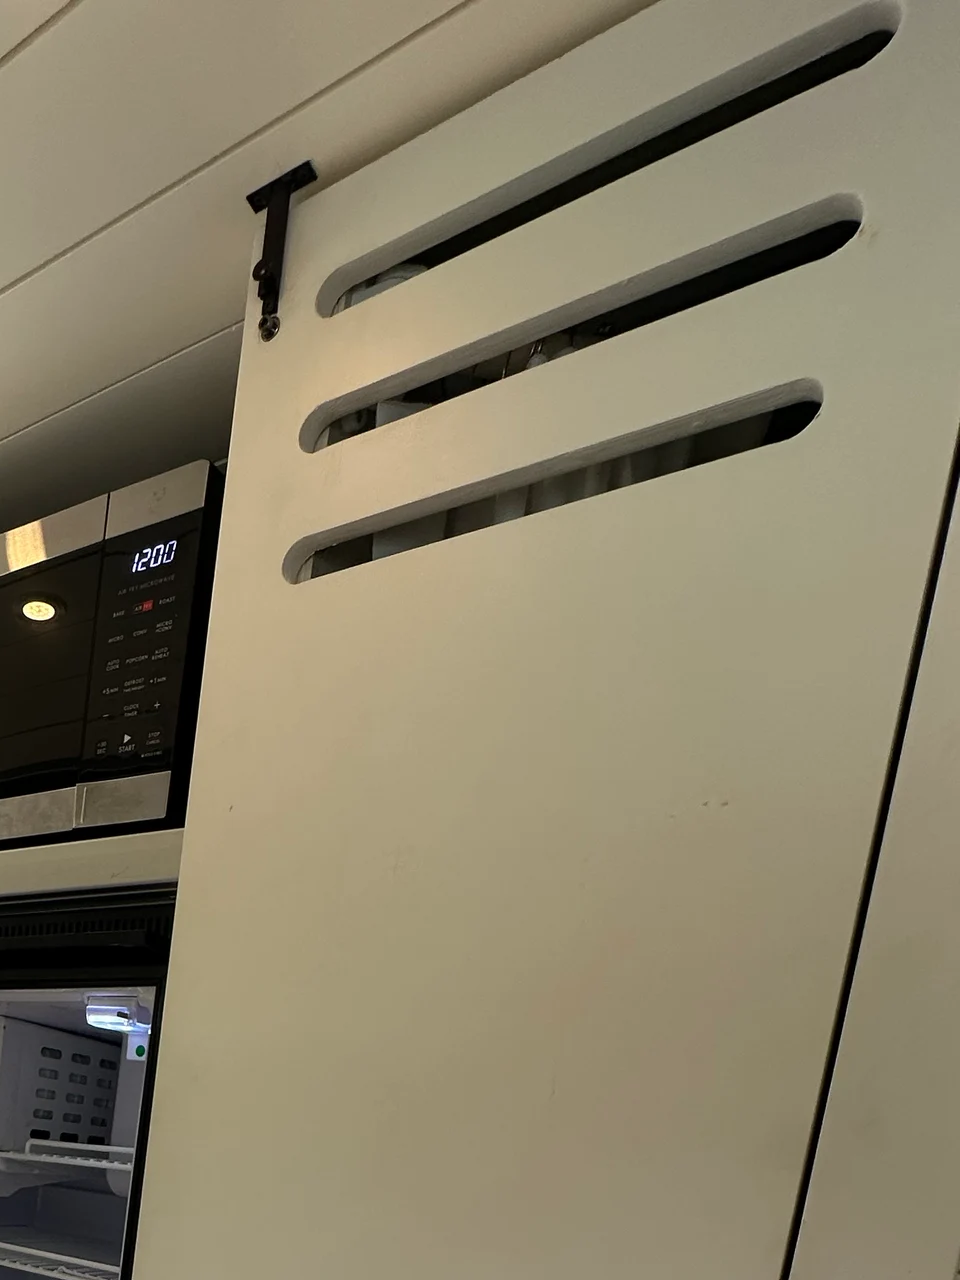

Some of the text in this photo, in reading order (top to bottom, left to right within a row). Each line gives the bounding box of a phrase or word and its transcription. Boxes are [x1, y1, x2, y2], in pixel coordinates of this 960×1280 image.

[132, 540, 177, 573] 1200
[125, 655, 149, 664] POPCORN
[118, 743, 136, 753] START
